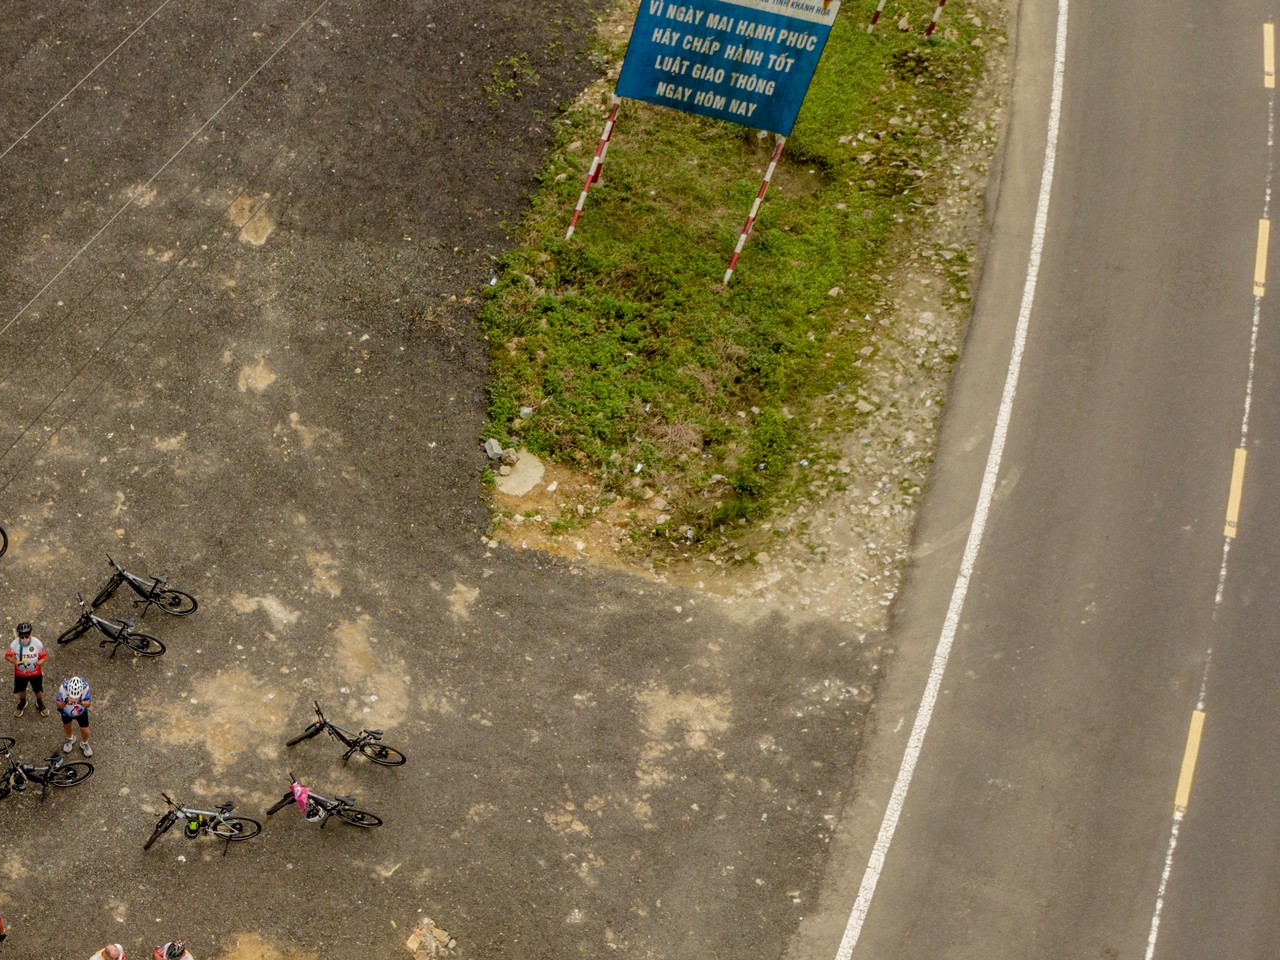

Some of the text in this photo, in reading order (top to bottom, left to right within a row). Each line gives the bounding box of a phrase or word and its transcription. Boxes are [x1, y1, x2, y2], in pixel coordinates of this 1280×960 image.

[666, 4, 704, 25] NGÀY
[706, 13, 734, 33] MAI
[735, 19, 776, 42] HẠNH
[776, 29, 818, 52] PHÚC
[790, 1, 816, 13] KHÁNH
[651, 27, 795, 73] HÃY CHẤP HÀNH TỐT
[654, 54, 776, 96] LUẬT GIAO THÔNG
[655, 81, 758, 117] NGAY HÔM NAY
